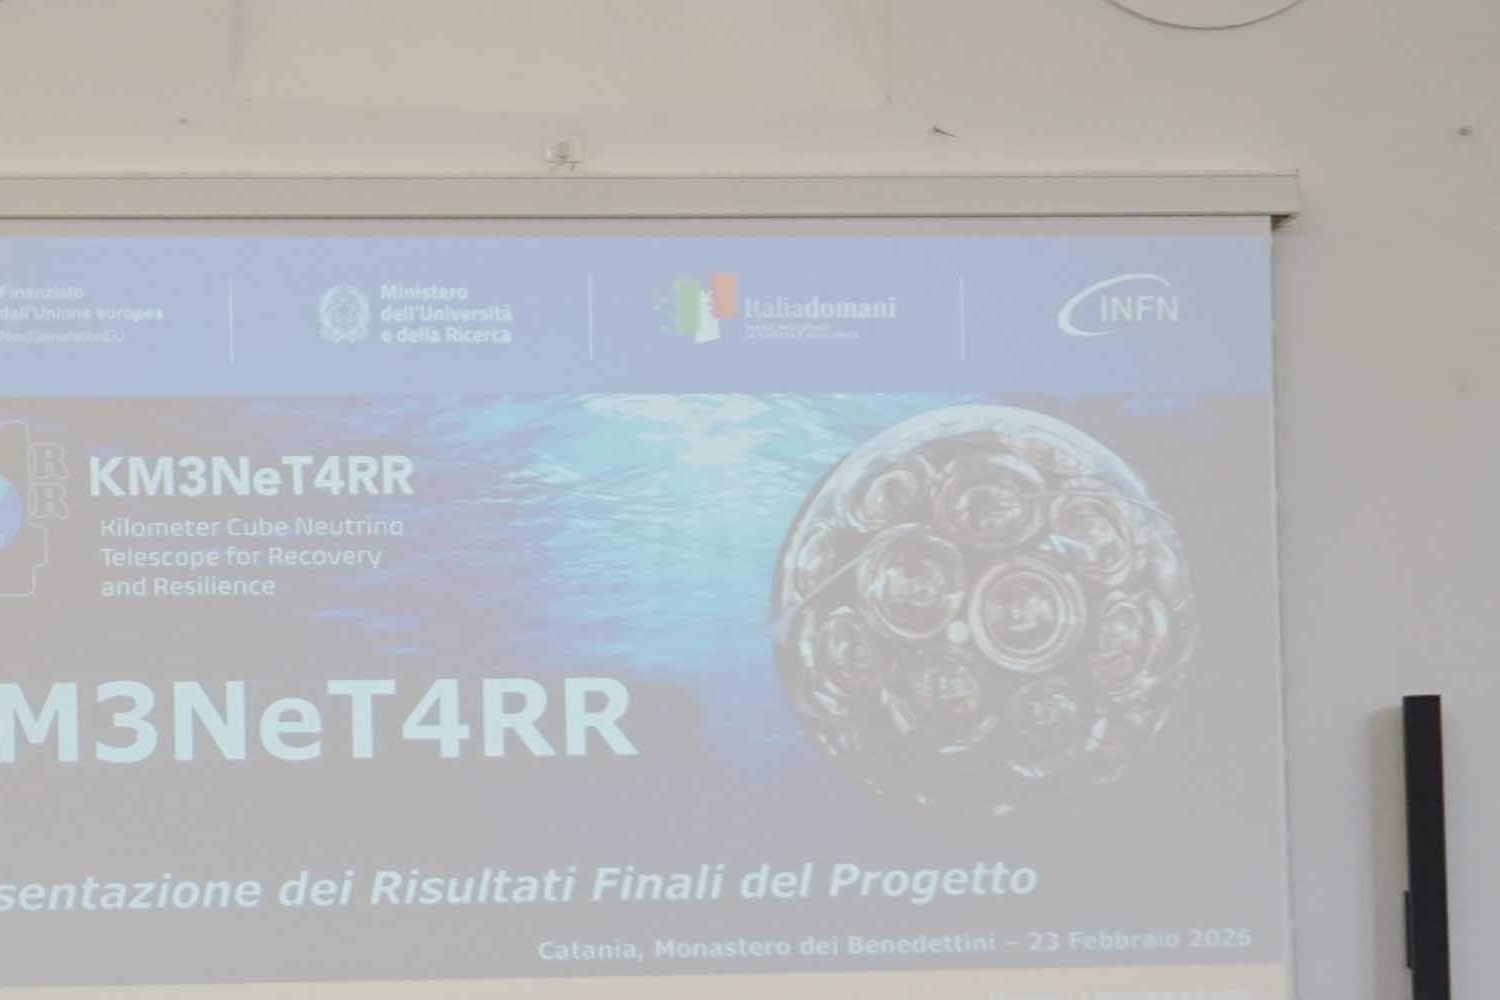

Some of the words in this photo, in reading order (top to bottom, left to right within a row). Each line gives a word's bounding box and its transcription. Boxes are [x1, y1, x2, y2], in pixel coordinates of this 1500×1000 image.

[380, 282, 468, 300] Ministero
[380, 304, 513, 321] dell'Università
[1100, 294, 1179, 321] INFN
[380, 329, 392, 343] e
[396, 326, 441, 343] della
[445, 326, 513, 343] Ricerca
[89, 455, 414, 497] KM3NeT4RR
[100, 517, 219, 537] Kilometer
[227, 516, 289, 537] Cube
[295, 516, 404, 537] Neutrino
[100, 547, 219, 571] Telescope
[226, 545, 261, 566] for
[268, 546, 382, 569] Recovery
[100, 576, 146, 597] and
[153, 575, 276, 597] Resilience
[279, 869, 353, 906] dei
[370, 866, 576, 905] Risultati
[591, 864, 724, 901] Finali
[738, 862, 813, 898] del
[829, 861, 1039, 904] Progetto
[538, 939, 644, 964] Catania,
[654, 938, 791, 959] Monastero
[800, 935, 839, 956] dei
[849, 931, 996, 955] Benedettini
[1027, 930, 1061, 951] 23
[1068, 929, 1180, 950] Febbraio
[1187, 927, 1253, 948] 2026
